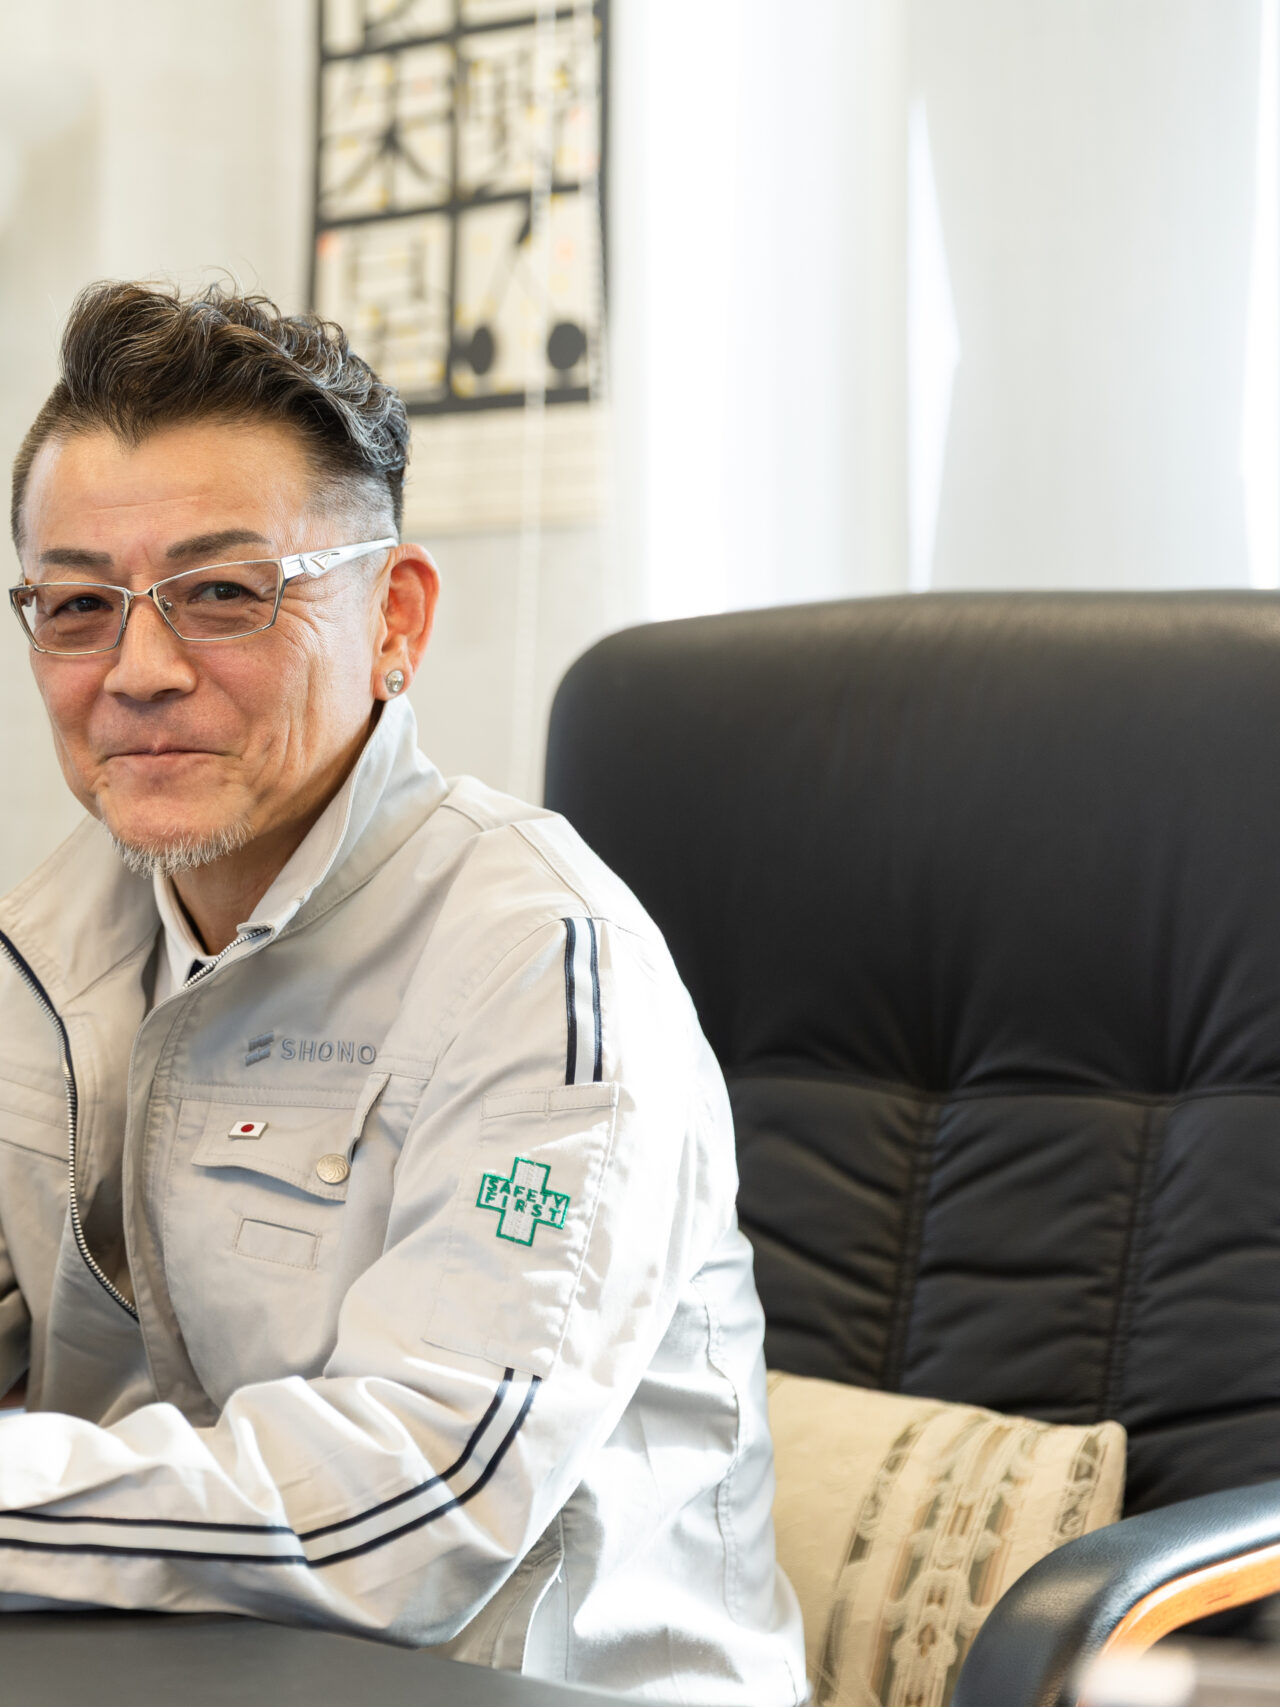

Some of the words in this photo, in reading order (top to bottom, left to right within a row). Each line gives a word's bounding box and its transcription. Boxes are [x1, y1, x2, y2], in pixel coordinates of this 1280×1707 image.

[281, 1039, 377, 1065] SHONO
[485, 1191, 561, 1222] FIRST
[486, 1178, 567, 1209] SAFETY
